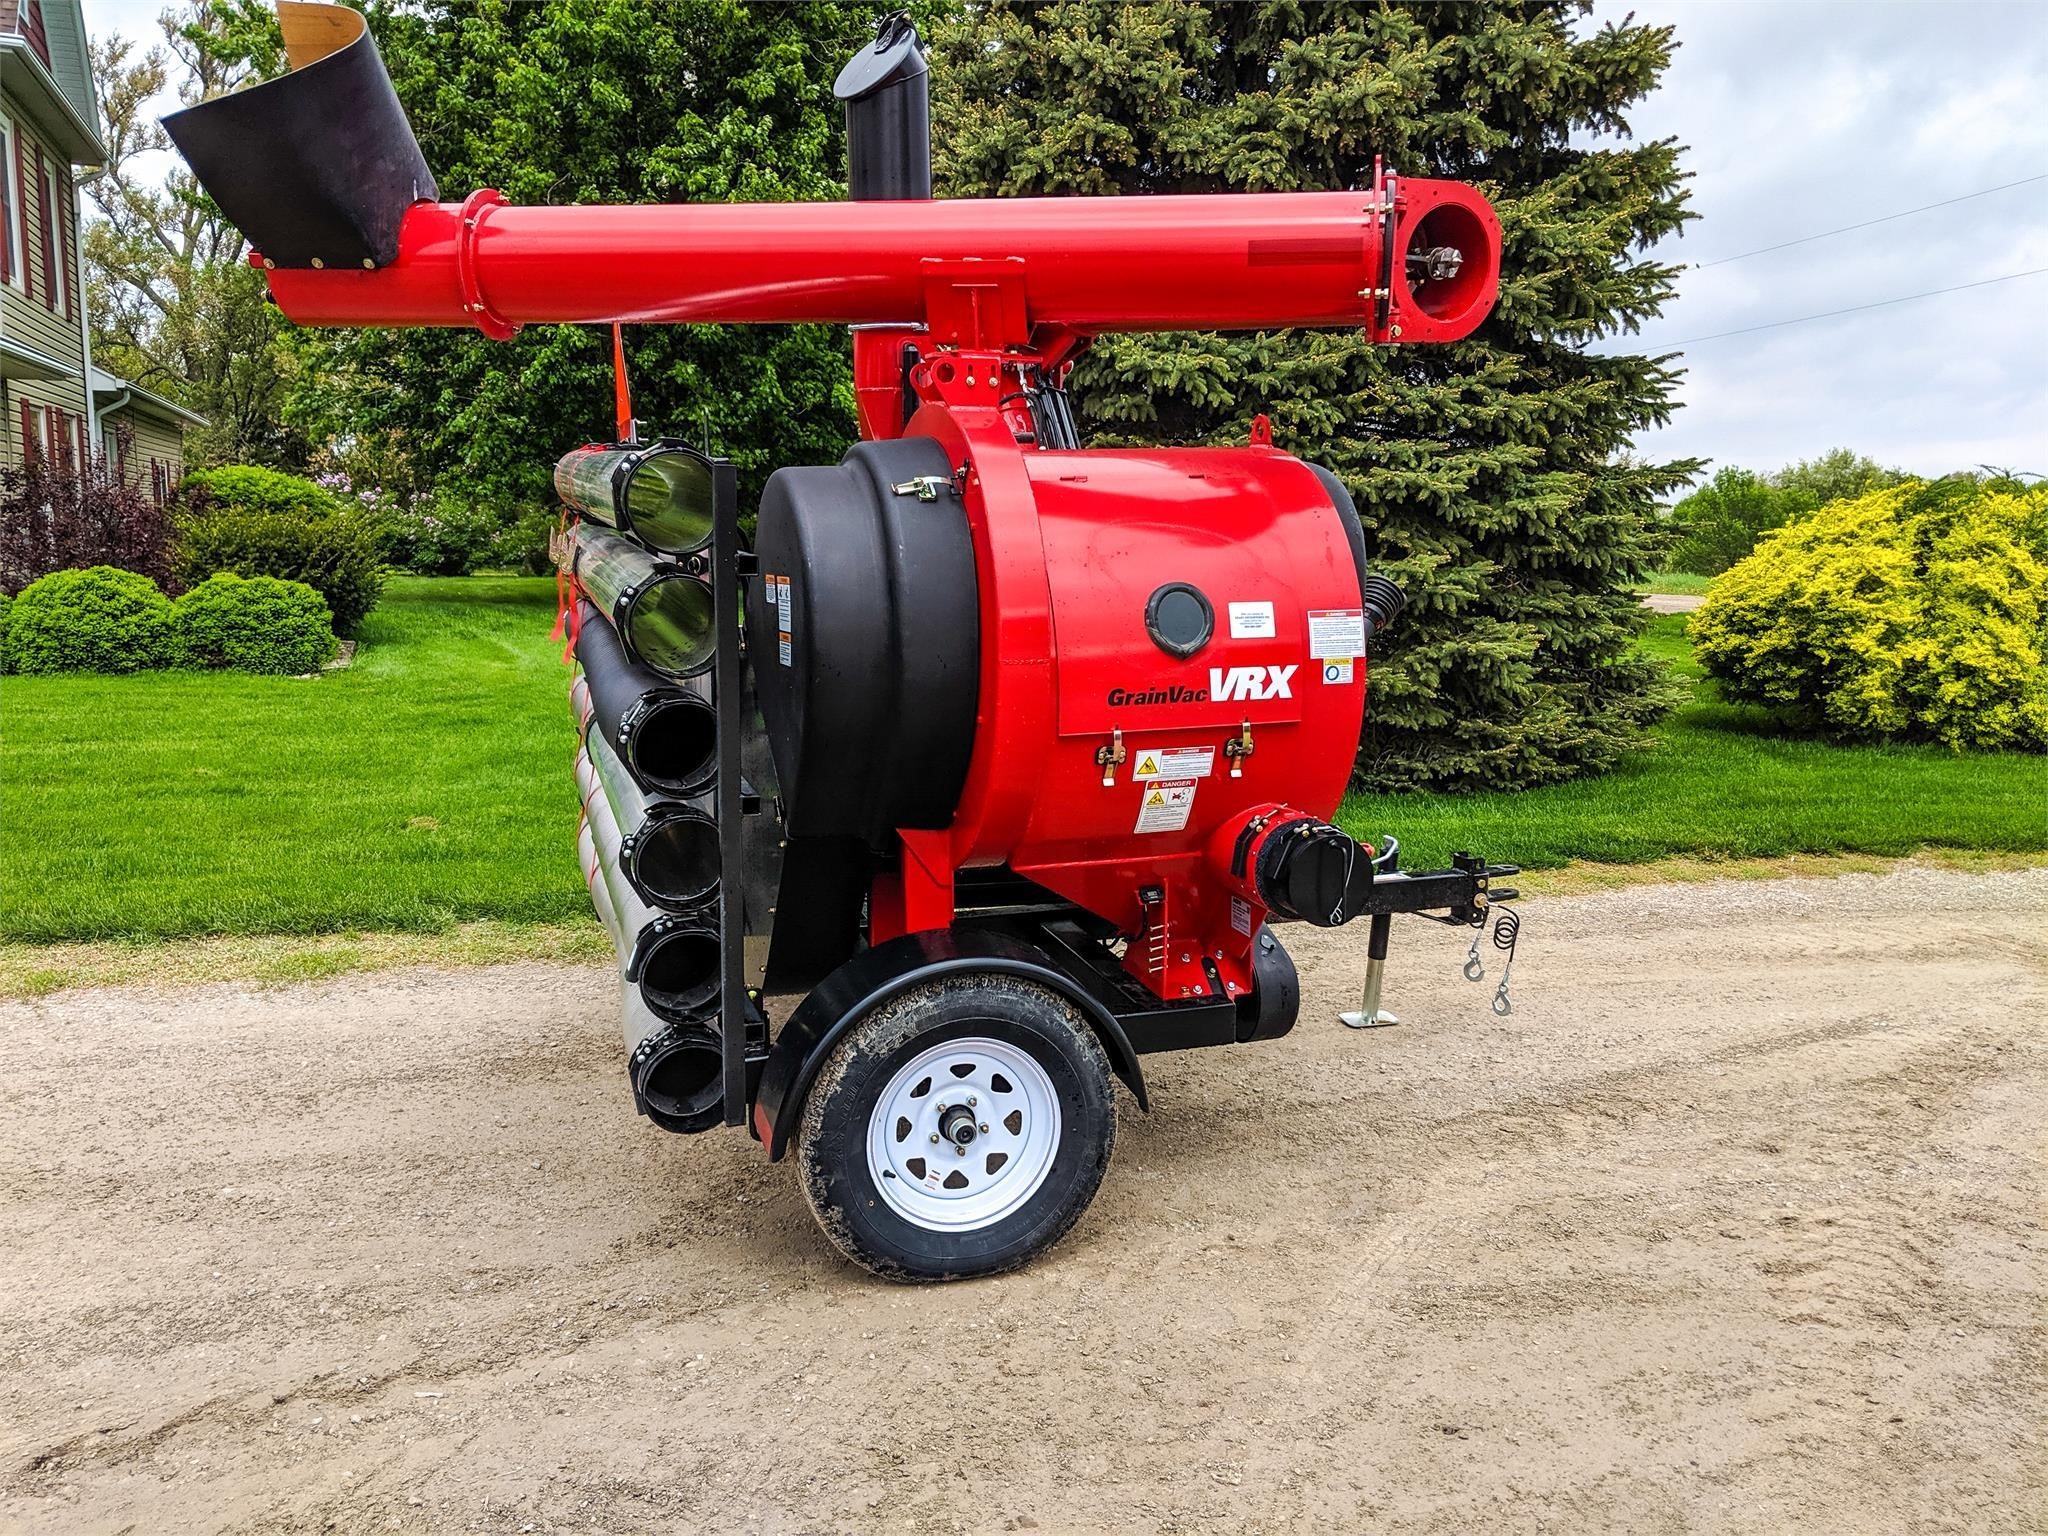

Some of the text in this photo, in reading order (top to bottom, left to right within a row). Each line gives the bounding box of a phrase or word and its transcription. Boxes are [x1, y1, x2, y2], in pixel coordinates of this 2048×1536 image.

[1107, 665, 1299, 706] GrainVac VRX
[1162, 780, 1192, 788] DANGER
